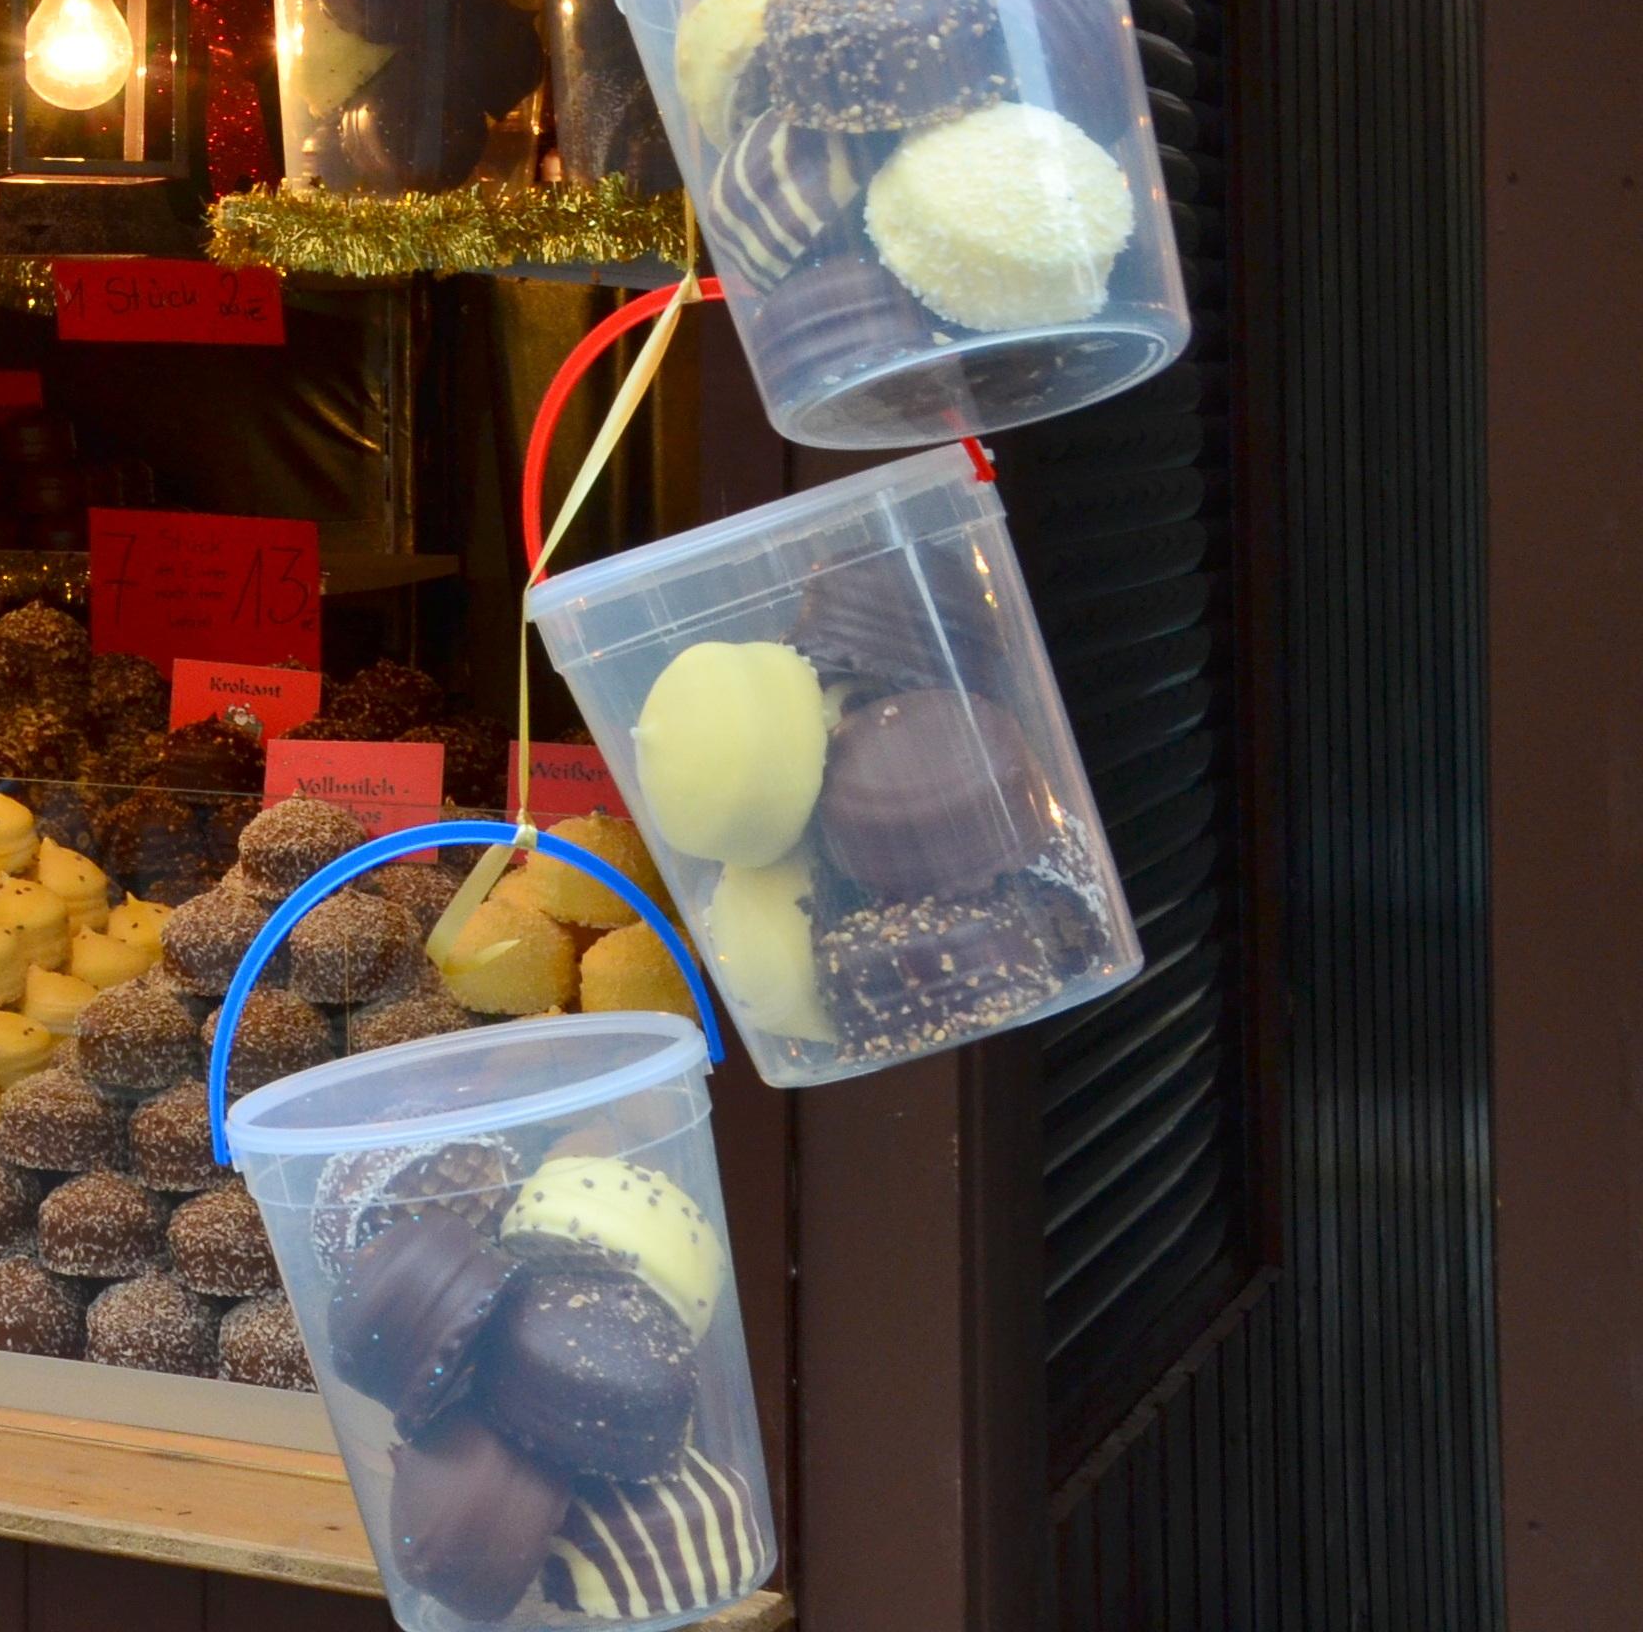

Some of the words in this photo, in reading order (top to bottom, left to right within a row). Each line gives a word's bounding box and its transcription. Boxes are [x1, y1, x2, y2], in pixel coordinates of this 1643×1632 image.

[105, 276, 199, 314] Stück
[209, 676, 283, 698] Krokant
[297, 776, 395, 797] Vollmilch
